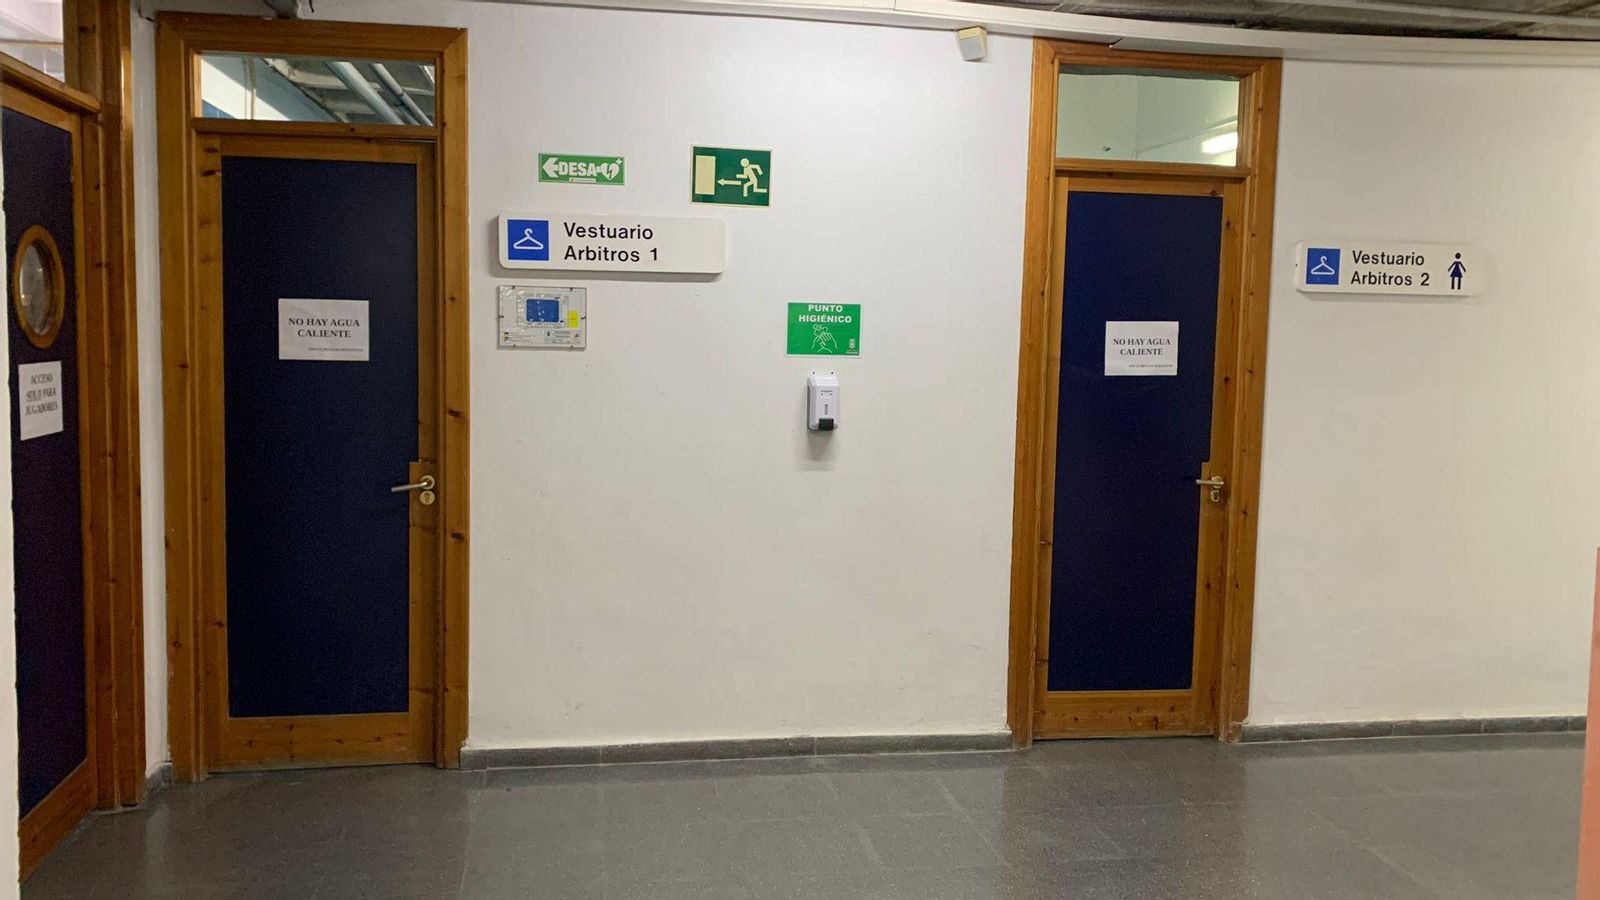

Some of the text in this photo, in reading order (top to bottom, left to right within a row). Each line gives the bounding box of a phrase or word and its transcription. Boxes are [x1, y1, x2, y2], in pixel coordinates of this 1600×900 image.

[558, 161, 597, 177] DESA
[563, 222, 653, 240] Vestuario
[564, 245, 658, 262] Arbitros 1
[1352, 250, 1425, 266] Vestuario
[1350, 270, 1430, 287] Arbitros 2
[808, 304, 843, 312] PUNTO
[288, 318, 360, 327] NO HAY AGUA
[798, 313, 852, 323] HIGIÉNICO
[297, 329, 351, 338] CALIENTE
[1146, 338, 1171, 346] AGUA
[1120, 348, 1164, 356] CALIENTE
